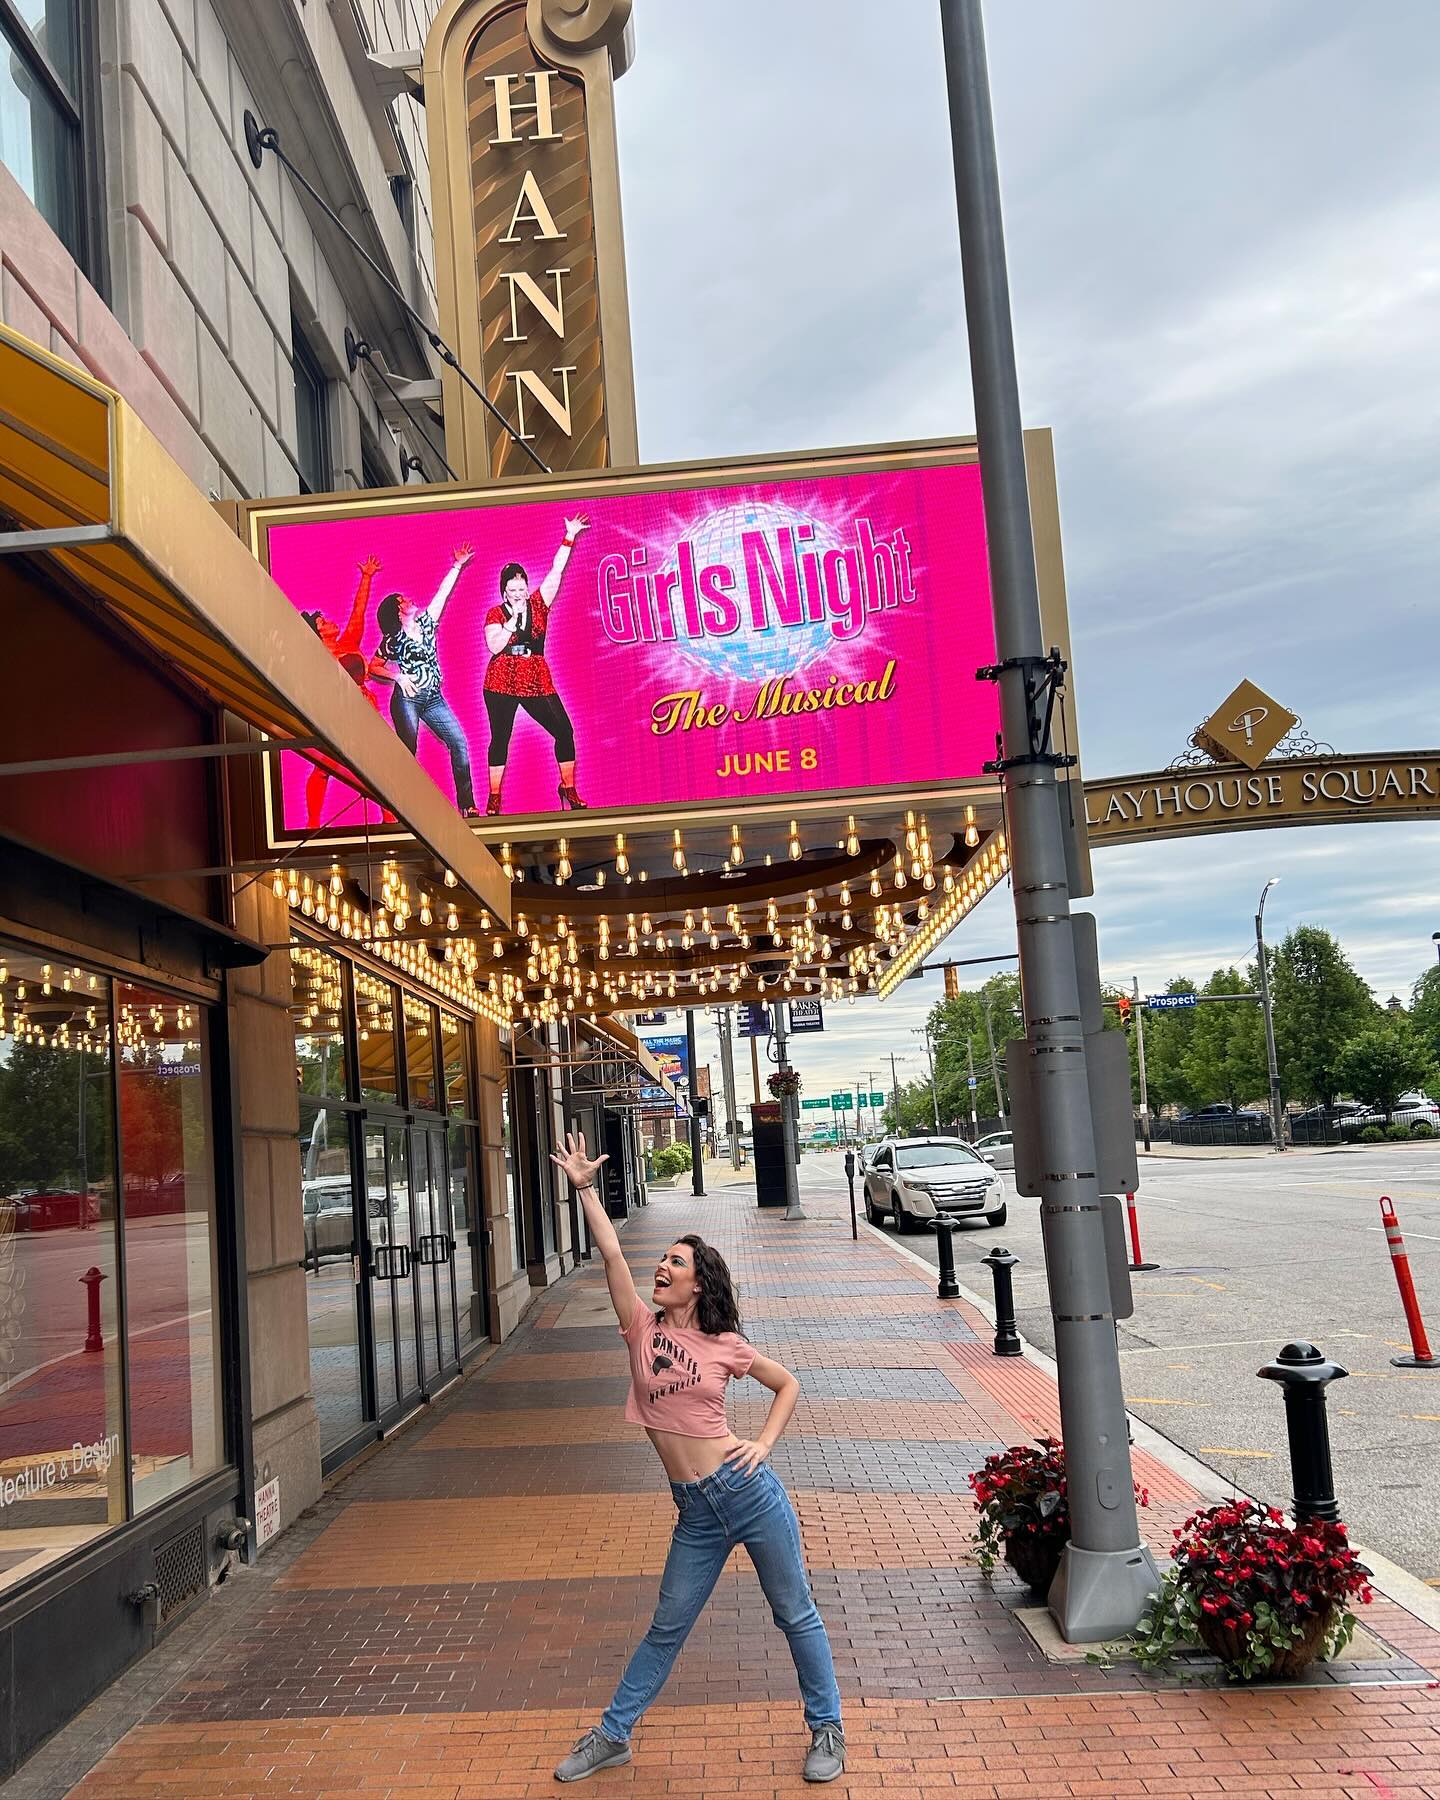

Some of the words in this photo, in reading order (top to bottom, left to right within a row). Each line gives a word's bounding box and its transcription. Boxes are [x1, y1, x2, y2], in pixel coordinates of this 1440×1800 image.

[484, 70, 577, 474] HANN
[597, 541, 741, 644] Girls
[741, 518, 918, 642] Night
[650, 690, 731, 736] The
[732, 659, 898, 724] Musical
[716, 750, 791, 778] JUNE
[800, 748, 818, 770] 8
[1302, 767, 1440, 805] SQUAR
[792, 1000, 819, 1011] AKES
[1149, 995, 1195, 1007] Prospect
[652, 1332, 685, 1363] SANTA
[687, 1358, 697, 1375] FE
[649, 1388, 666, 1404] NEW
[669, 1374, 701, 1395] MEXICO
[60, 1457, 68, 1480] &
[72, 1432, 120, 1475] Design
[256, 1498, 278, 1526] THEATRE
